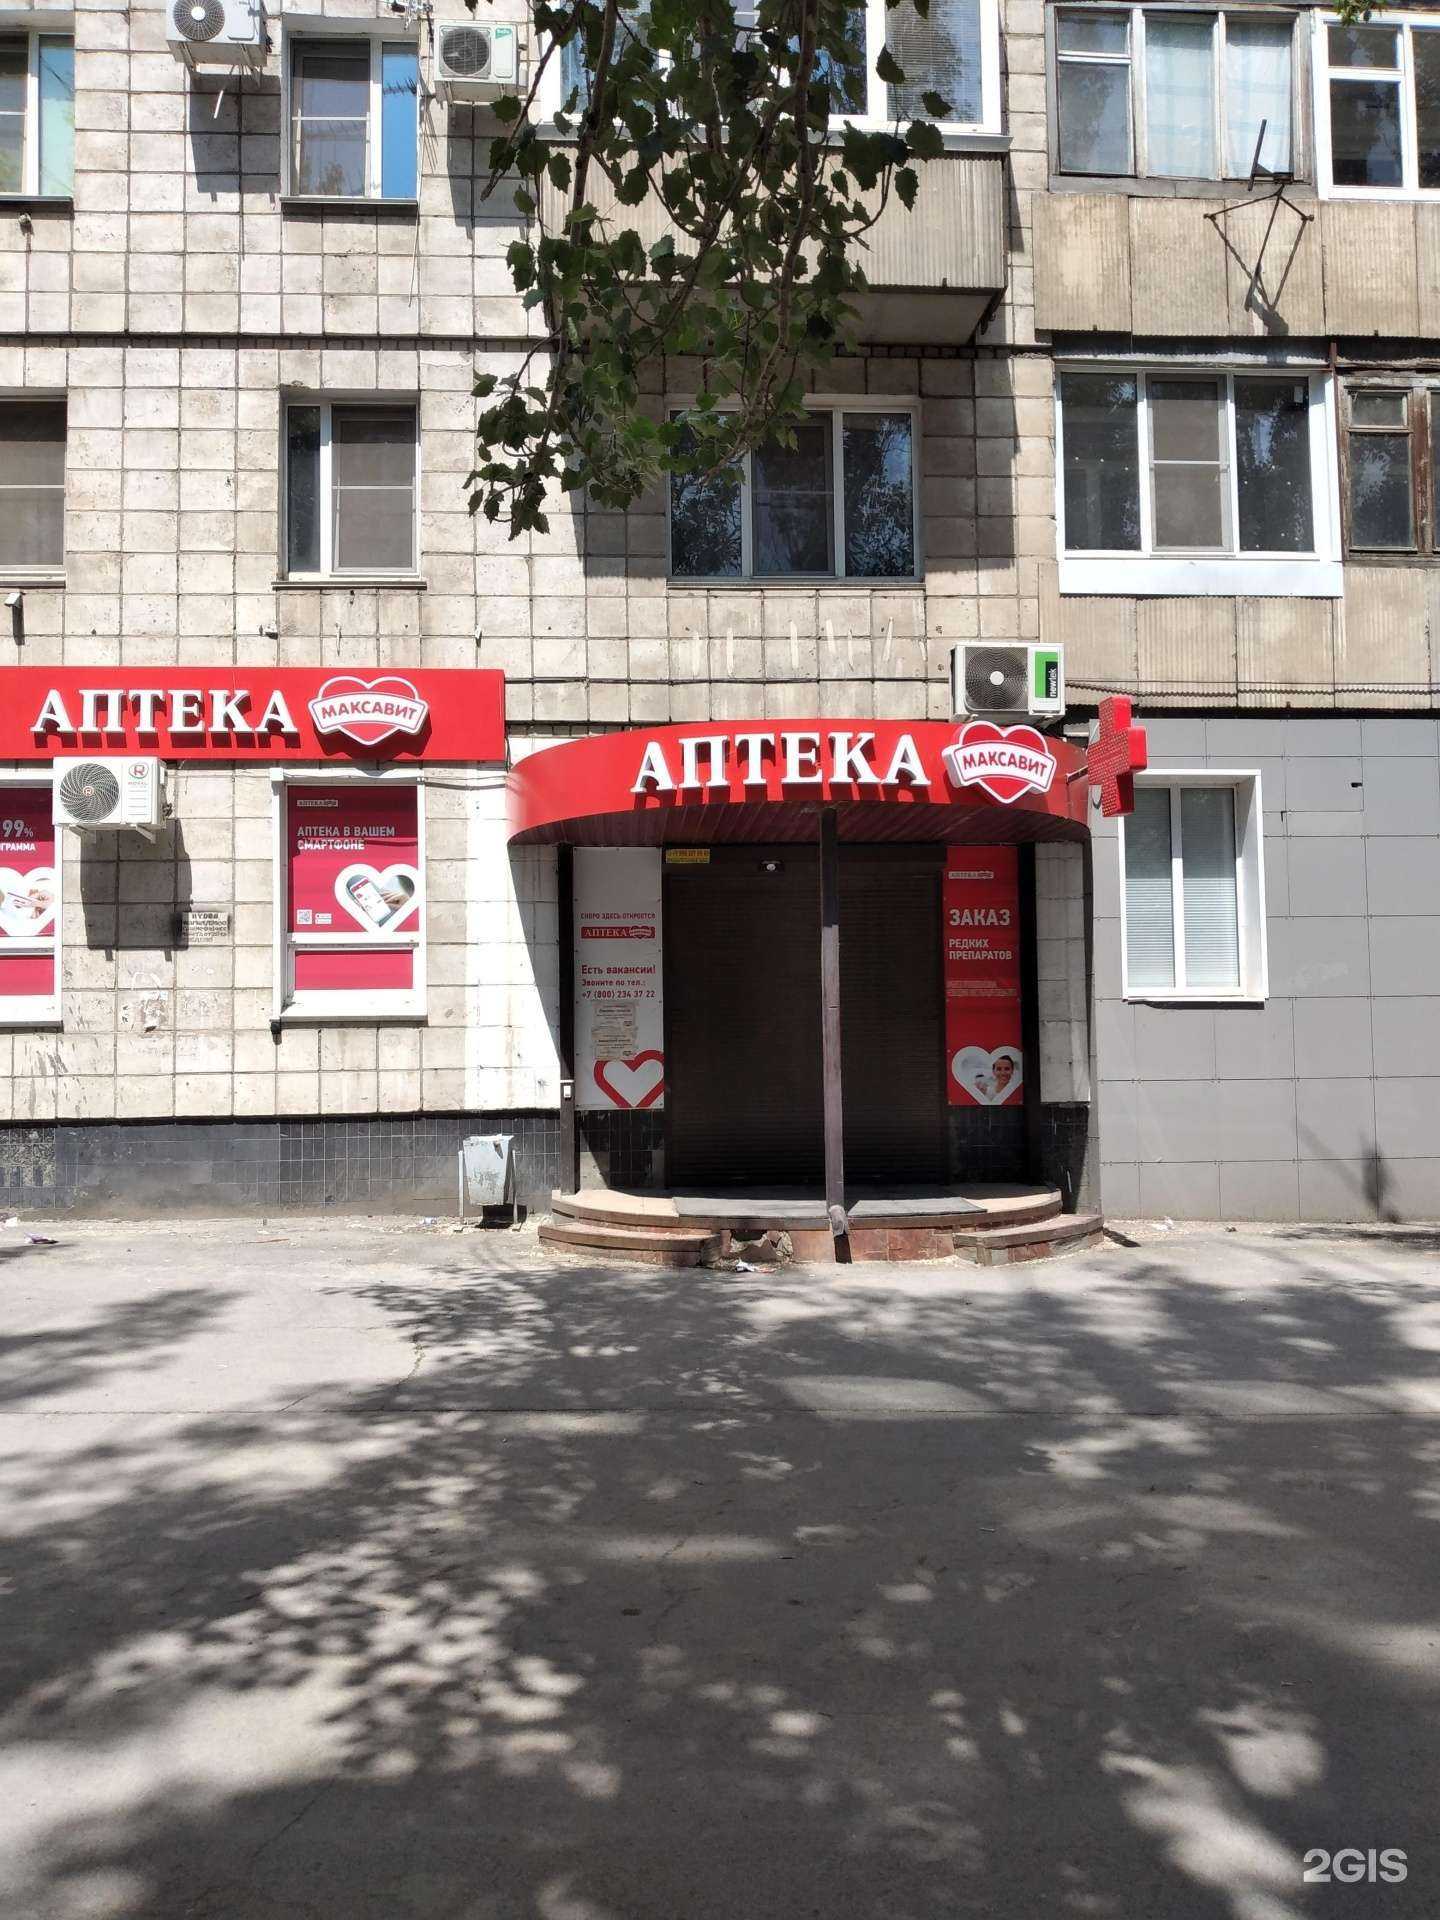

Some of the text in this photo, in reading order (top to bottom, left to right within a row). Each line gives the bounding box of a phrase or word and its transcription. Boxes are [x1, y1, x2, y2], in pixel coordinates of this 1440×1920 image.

[30, 688, 299, 733] АПТЕКА
[321, 700, 417, 720] МАКСАВИТ
[630, 732, 931, 793] АПТЕКА
[962, 751, 1047, 777] МАКСАВИТ
[297, 826, 395, 837] АПТЕКА В ВАШЕМ
[0, 842, 36, 852] ГРАММА
[297, 839, 365, 850] СМАРТФОНЕ
[949, 908, 1010, 926] ЗАКАЗ
[584, 928, 627, 937] АПТЕКА
[949, 938, 989, 949] РЕДКИХ
[949, 950, 1012, 960] ПРЕПАРАТОВ
[581, 964, 656, 974] Есть вакансии!
[582, 979, 614, 987] Звоните
[582, 990, 655, 999] +7 (800) 234 37 22
